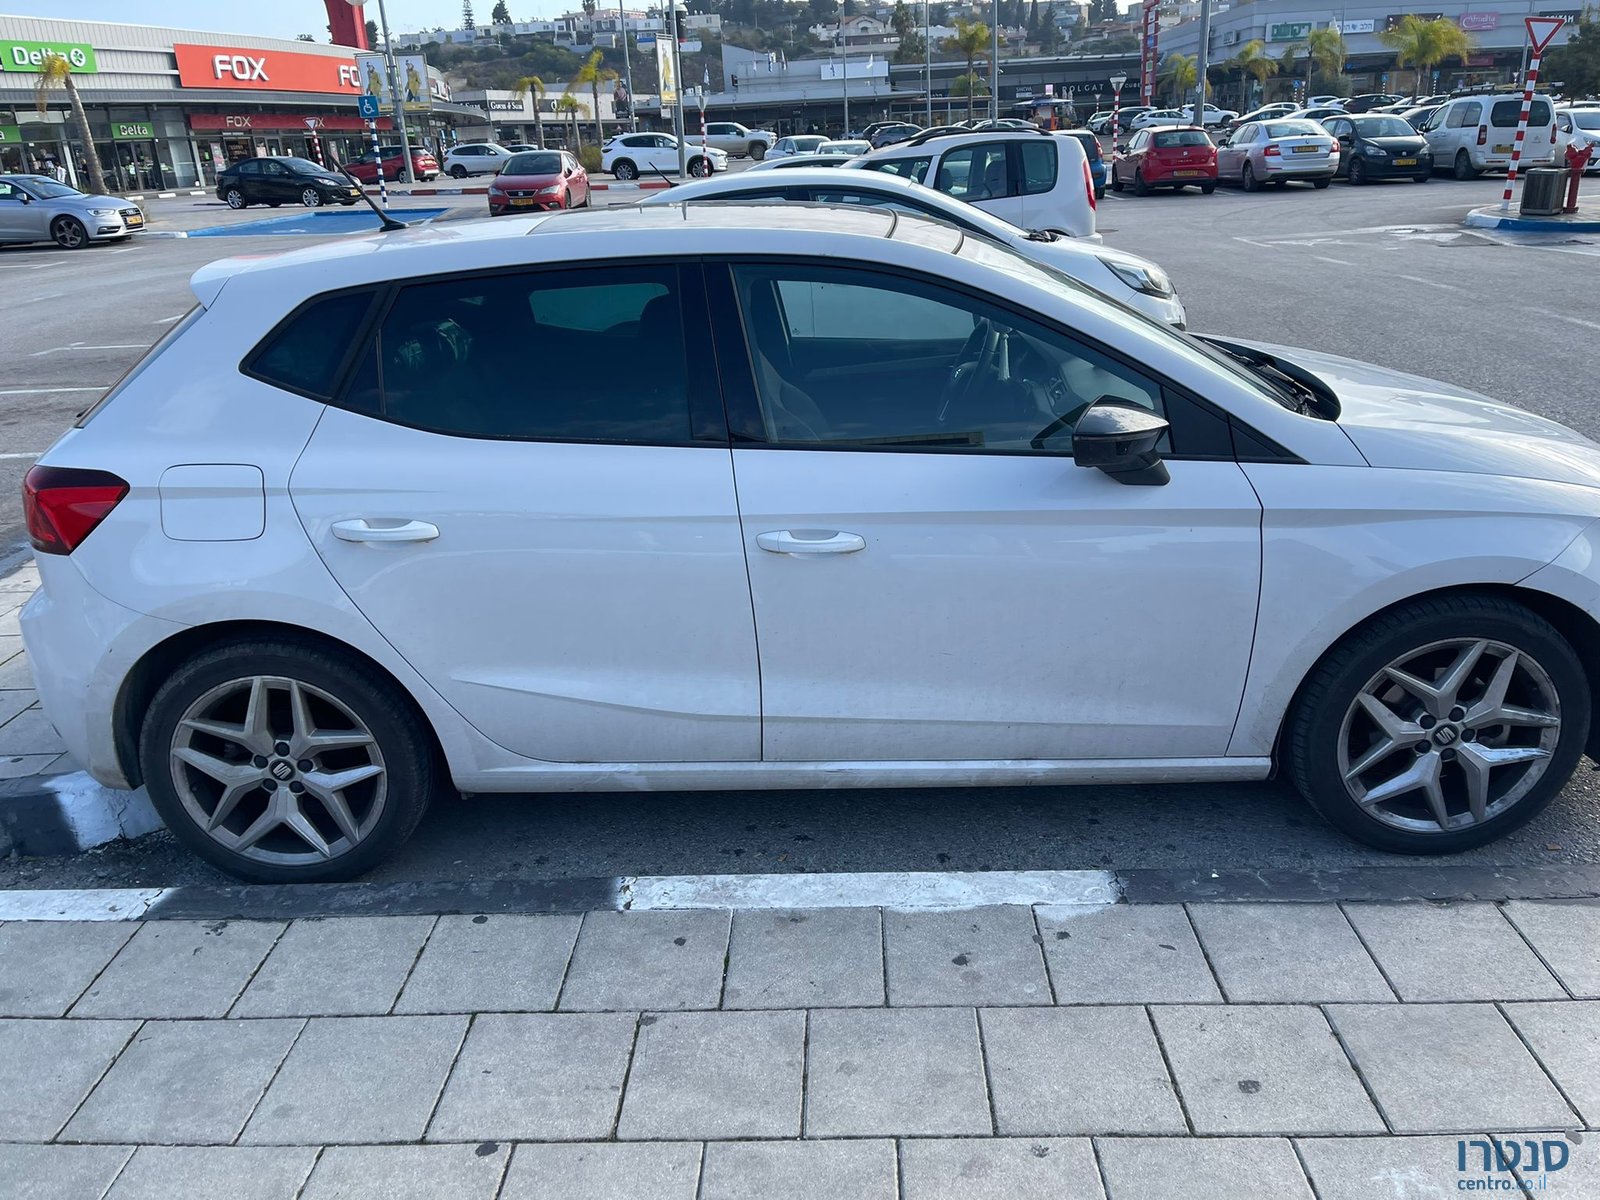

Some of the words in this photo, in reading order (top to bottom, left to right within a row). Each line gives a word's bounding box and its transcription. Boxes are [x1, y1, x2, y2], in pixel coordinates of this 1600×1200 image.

[213, 54, 269, 81] FOX
[339, 65, 361, 87] FO
[120, 124, 148, 136] Delta
[226, 116, 251, 127] FOX
